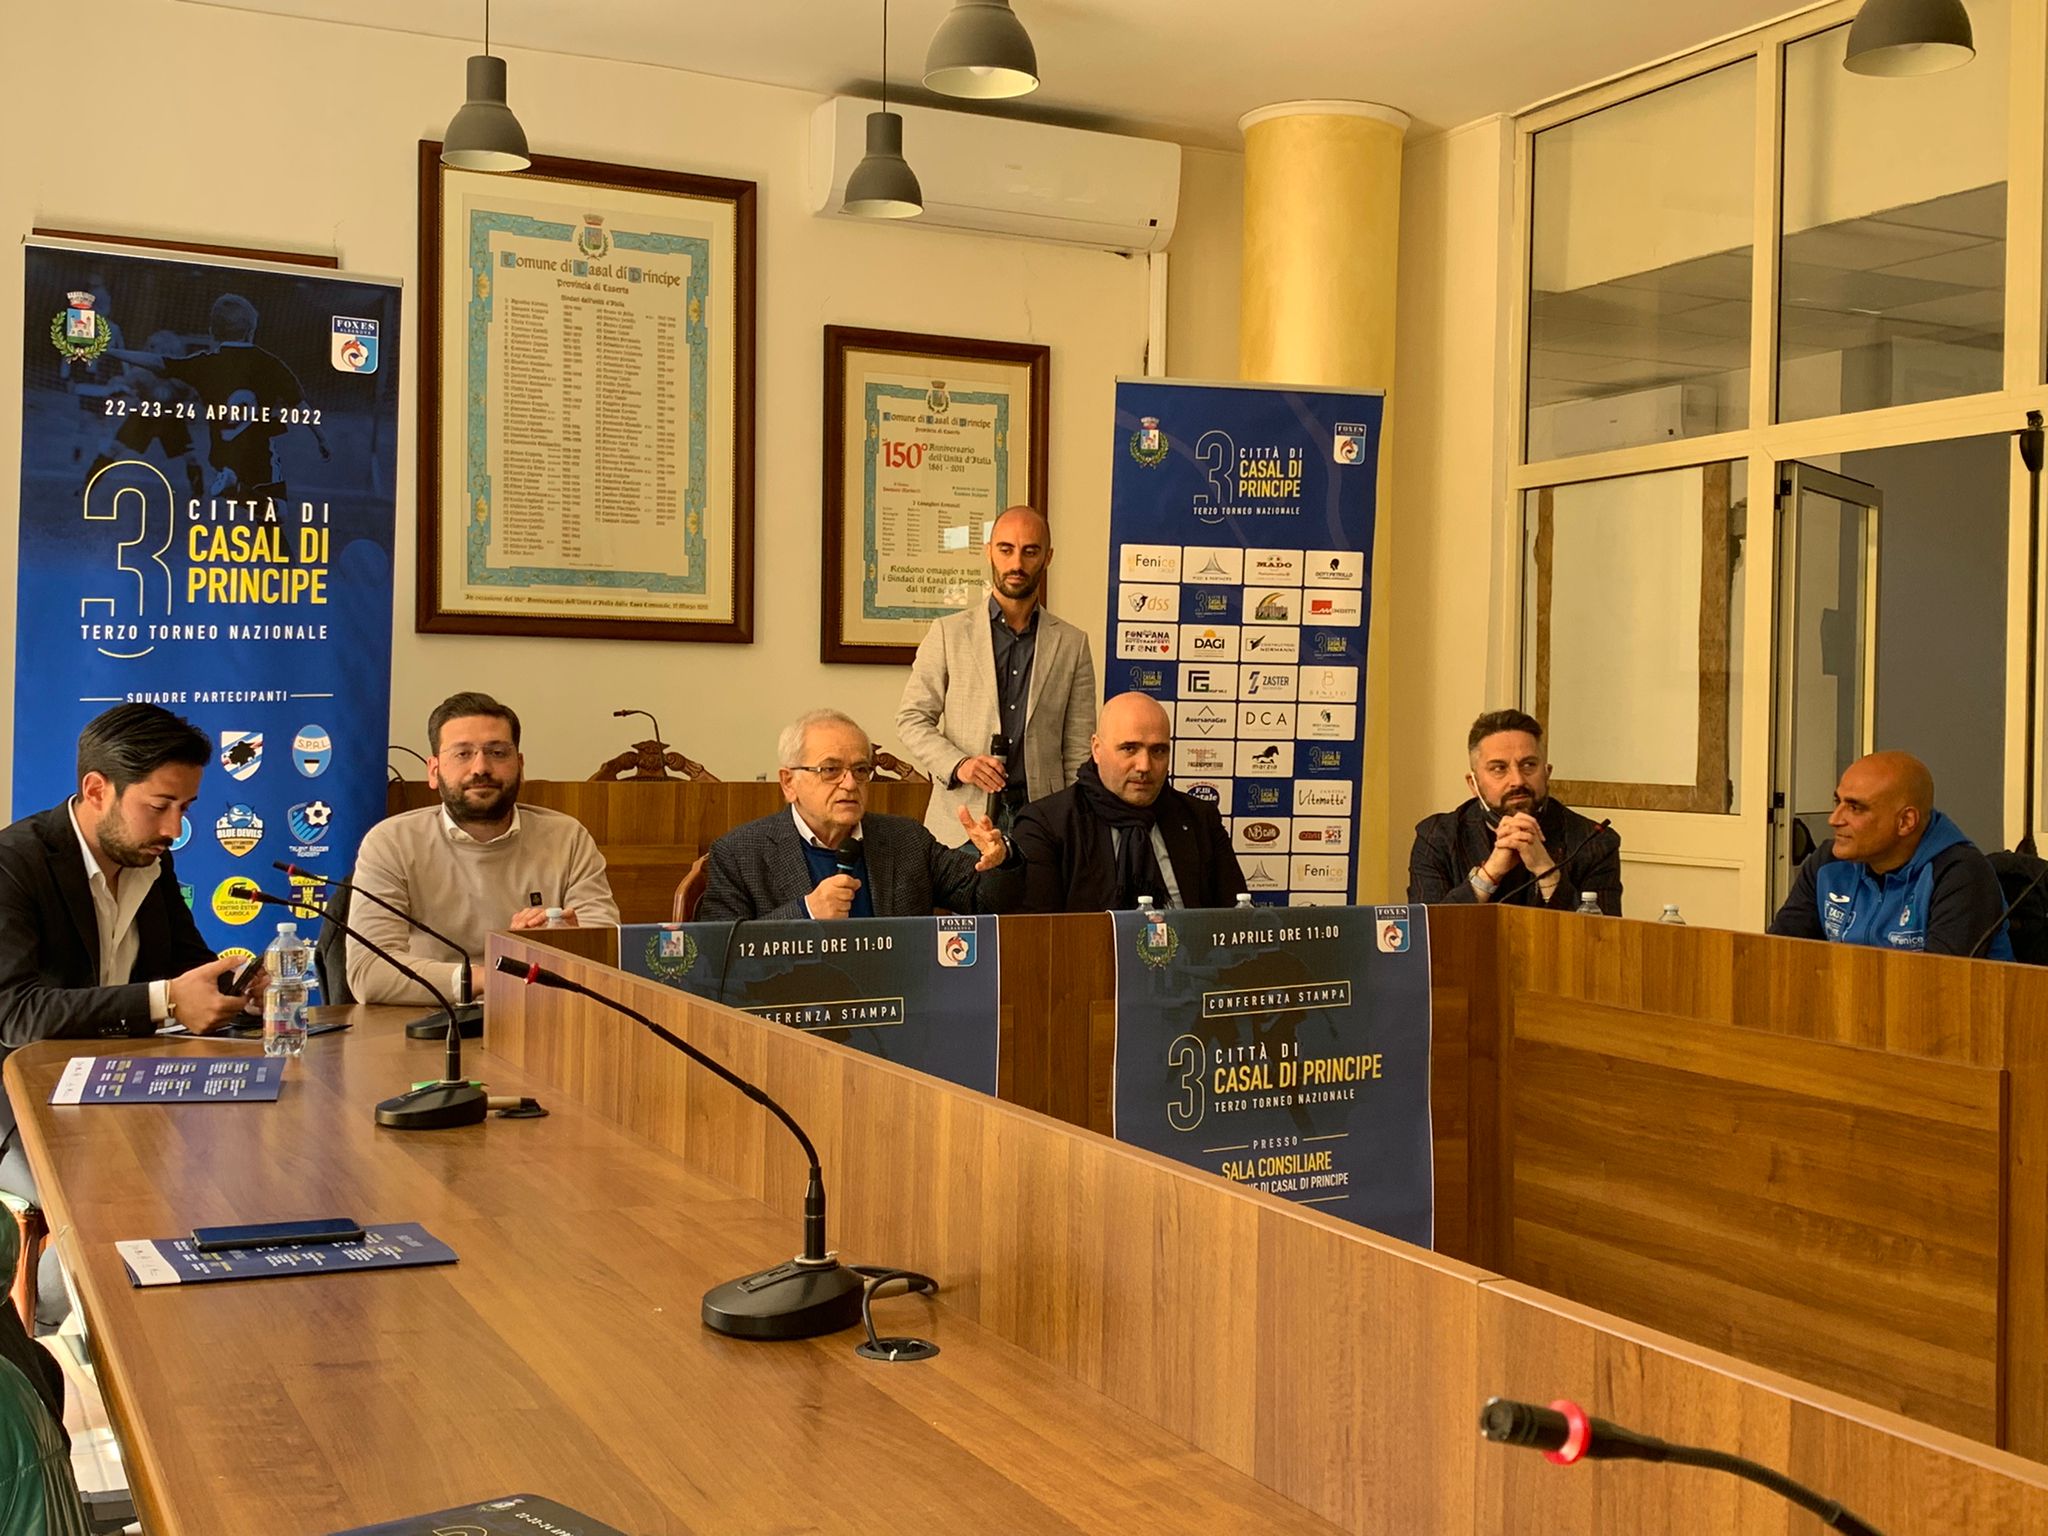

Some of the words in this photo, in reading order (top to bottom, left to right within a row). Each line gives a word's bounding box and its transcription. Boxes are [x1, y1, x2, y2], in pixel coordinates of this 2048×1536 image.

[501, 251, 557, 271] Comune
[560, 258, 572, 272] di
[616, 264, 627, 279] di
[628, 267, 681, 288] Principe
[337, 320, 375, 330] FOXES
[105, 401, 196, 419] 22-23-24
[206, 405, 270, 422] APRILE
[280, 408, 321, 425] 2022
[1240, 446, 1279, 459] CITTÀ
[1290, 448, 1303, 459] DI
[1240, 460, 1285, 478] CASAL
[1289, 461, 1302, 478] DI
[1239, 480, 1301, 498] PRINCIPE
[189, 497, 277, 521] CITTÀ
[302, 503, 329, 523] DI
[1193, 507, 1218, 515] TERZO
[1222, 507, 1252, 515] TORNEO
[1256, 507, 1300, 515] NAZIONALE
[188, 526, 289, 562] CASAL
[300, 527, 329, 563] DI
[1135, 554, 1176, 567] Fenice
[188, 568, 328, 604] PRINCIPE
[81, 625, 138, 640] TERZO
[150, 625, 218, 640] TORNEO
[230, 625, 327, 640] NAZIONALE
[1194, 638, 1225, 649] DAGI
[1263, 676, 1289, 686] ZASTER
[127, 692, 187, 704] SQUADRE
[195, 690, 287, 703] PARTECIPANTI
[237, 828, 263, 838] DEVILS
[1304, 864, 1343, 876] Fenice
[1212, 932, 1225, 946] 12
[1231, 930, 1273, 945] APRILE
[1280, 928, 1301, 942] ORE
[1307, 925, 1339, 940] 11:00
[739, 943, 755, 957] 12
[763, 939, 814, 957] APRILE
[821, 938, 847, 953] ORE
[855, 936, 893, 951] 11:00
[1209, 993, 1290, 1010] CONFERENZA
[1298, 988, 1345, 1003] STAMPA
[754, 1009, 831, 1024] FERENZA
[841, 1005, 897, 1020] STAMPA
[1167, 1034, 1206, 1131] 3
[1216, 1042, 1267, 1063] CITTÀ
[1281, 1042, 1299, 1058] DI
[1214, 1065, 1273, 1094] CASAL
[1279, 1062, 1297, 1088] DI
[1303, 1054, 1382, 1086] PRINCIPE
[1215, 1099, 1247, 1113] TERZO
[1252, 1095, 1292, 1109] TORNEO
[1298, 1089, 1355, 1105] NAZIONALE
[1253, 1136, 1298, 1150] PRESSO
[1221, 1160, 1255, 1181] SALA
[1258, 1151, 1332, 1177] CONSILIARE
[1271, 1178, 1298, 1193] CASAL
[1300, 1177, 1309, 1190] DI
[1311, 1172, 1349, 1188] PRINCIPE
